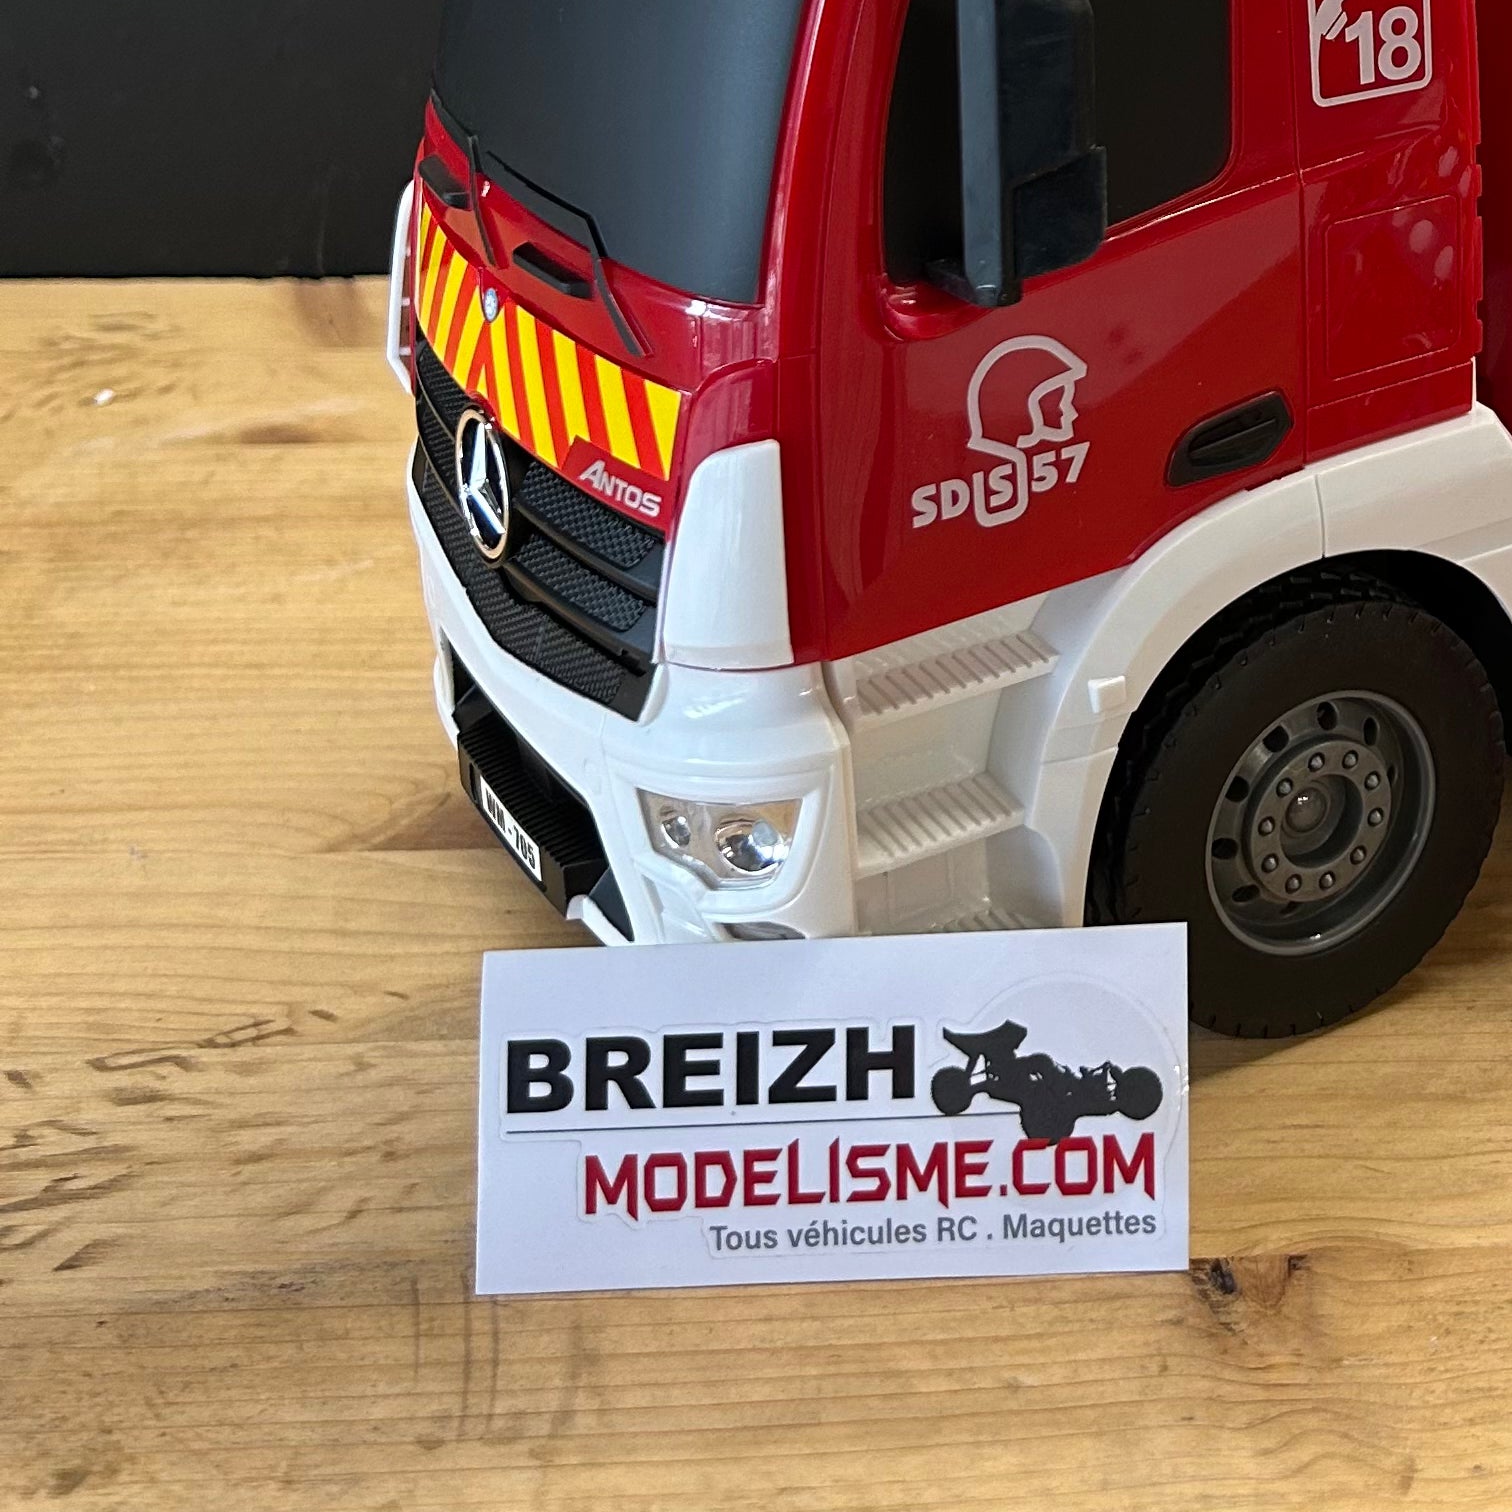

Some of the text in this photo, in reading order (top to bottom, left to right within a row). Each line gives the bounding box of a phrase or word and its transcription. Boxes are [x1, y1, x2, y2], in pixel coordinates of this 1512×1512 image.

[1345, 6, 1422, 85] 18
[506, 1025, 915, 1115] BREIZH
[584, 1133, 1155, 1221] MODELISME.COM
[710, 1224, 779, 1251] Tous
[787, 1218, 928, 1250] véhicules
[937, 1217, 978, 1243] RC
[1002, 1210, 1156, 1246] Maquettes
